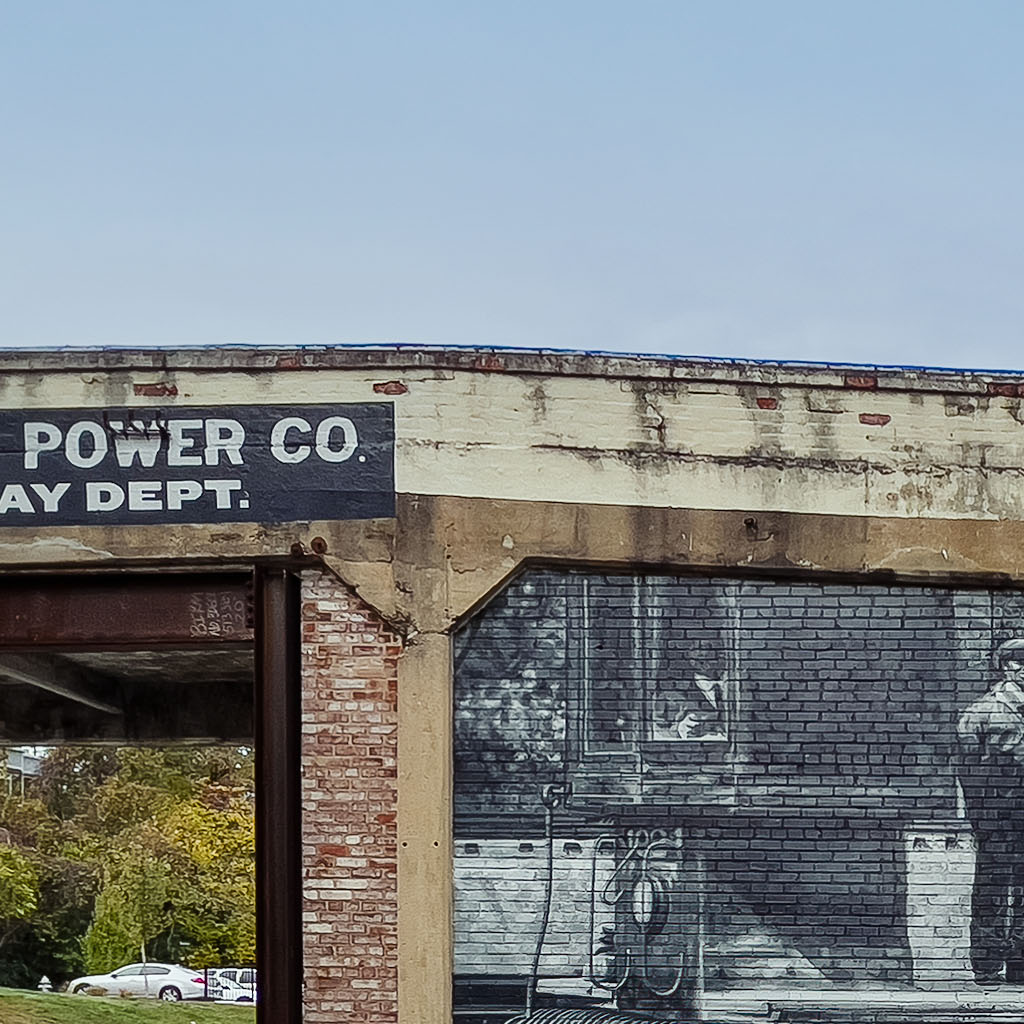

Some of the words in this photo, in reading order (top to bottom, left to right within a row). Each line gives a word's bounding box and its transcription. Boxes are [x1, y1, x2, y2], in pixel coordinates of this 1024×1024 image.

[23, 418, 246, 470] POWER
[270, 416, 366, 464] CO.
[0, 482, 72, 514] AY
[85, 479, 251, 512] DEPT.
